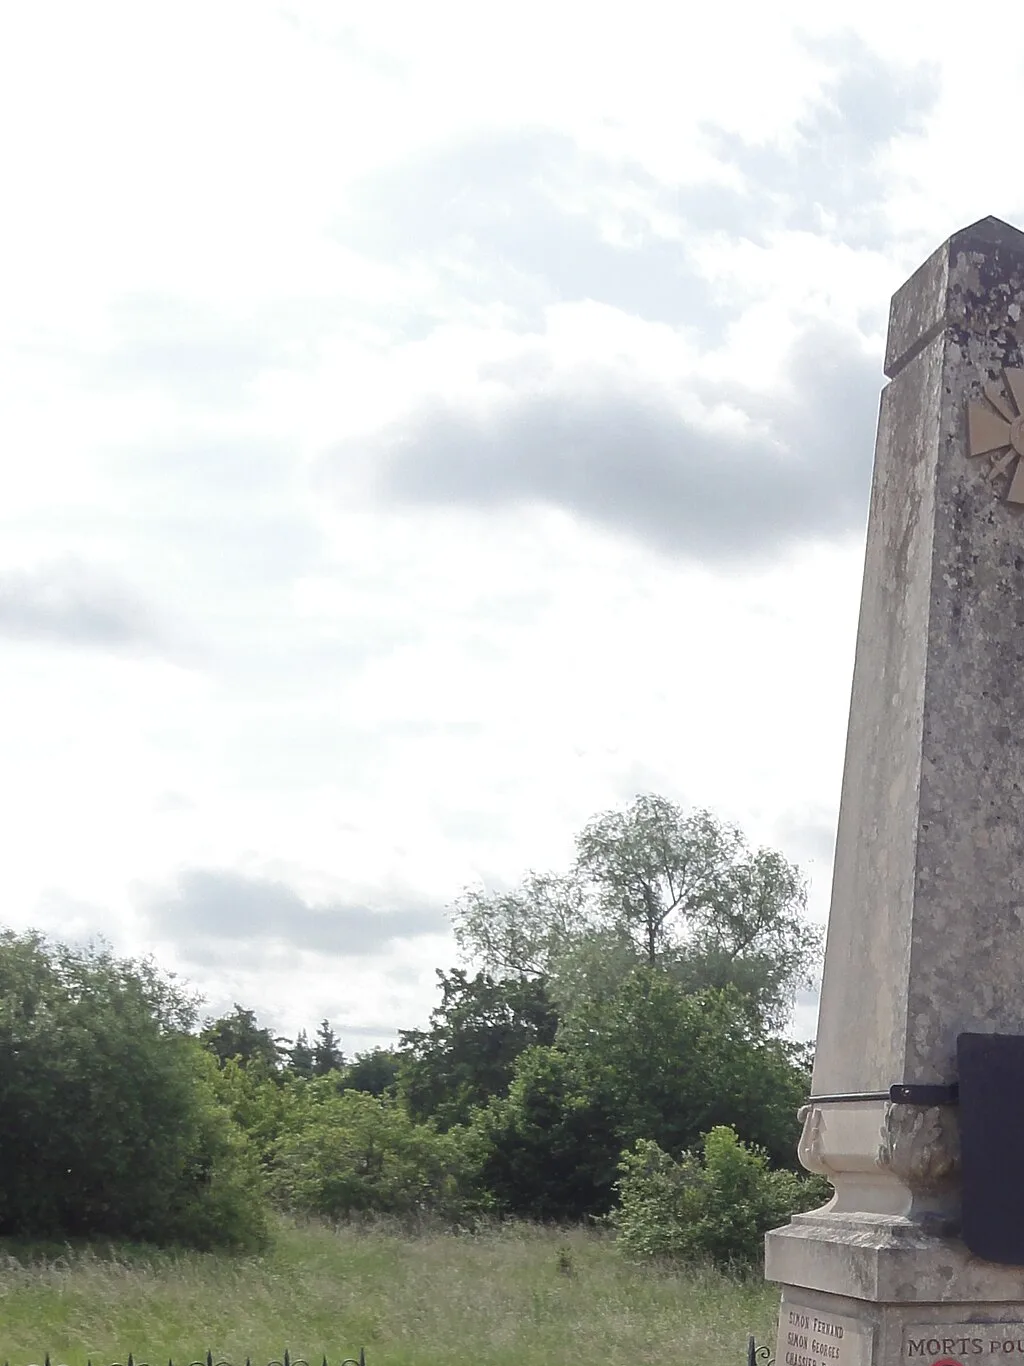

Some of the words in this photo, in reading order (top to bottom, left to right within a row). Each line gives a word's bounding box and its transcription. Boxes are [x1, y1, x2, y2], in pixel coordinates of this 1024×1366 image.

[789, 1312, 809, 1329] SIMON
[813, 1318, 844, 1339] FERNAND
[787, 1332, 808, 1349] SIMON
[811, 1339, 840, 1359] GEORGES
[908, 1338, 983, 1357] MORTS
